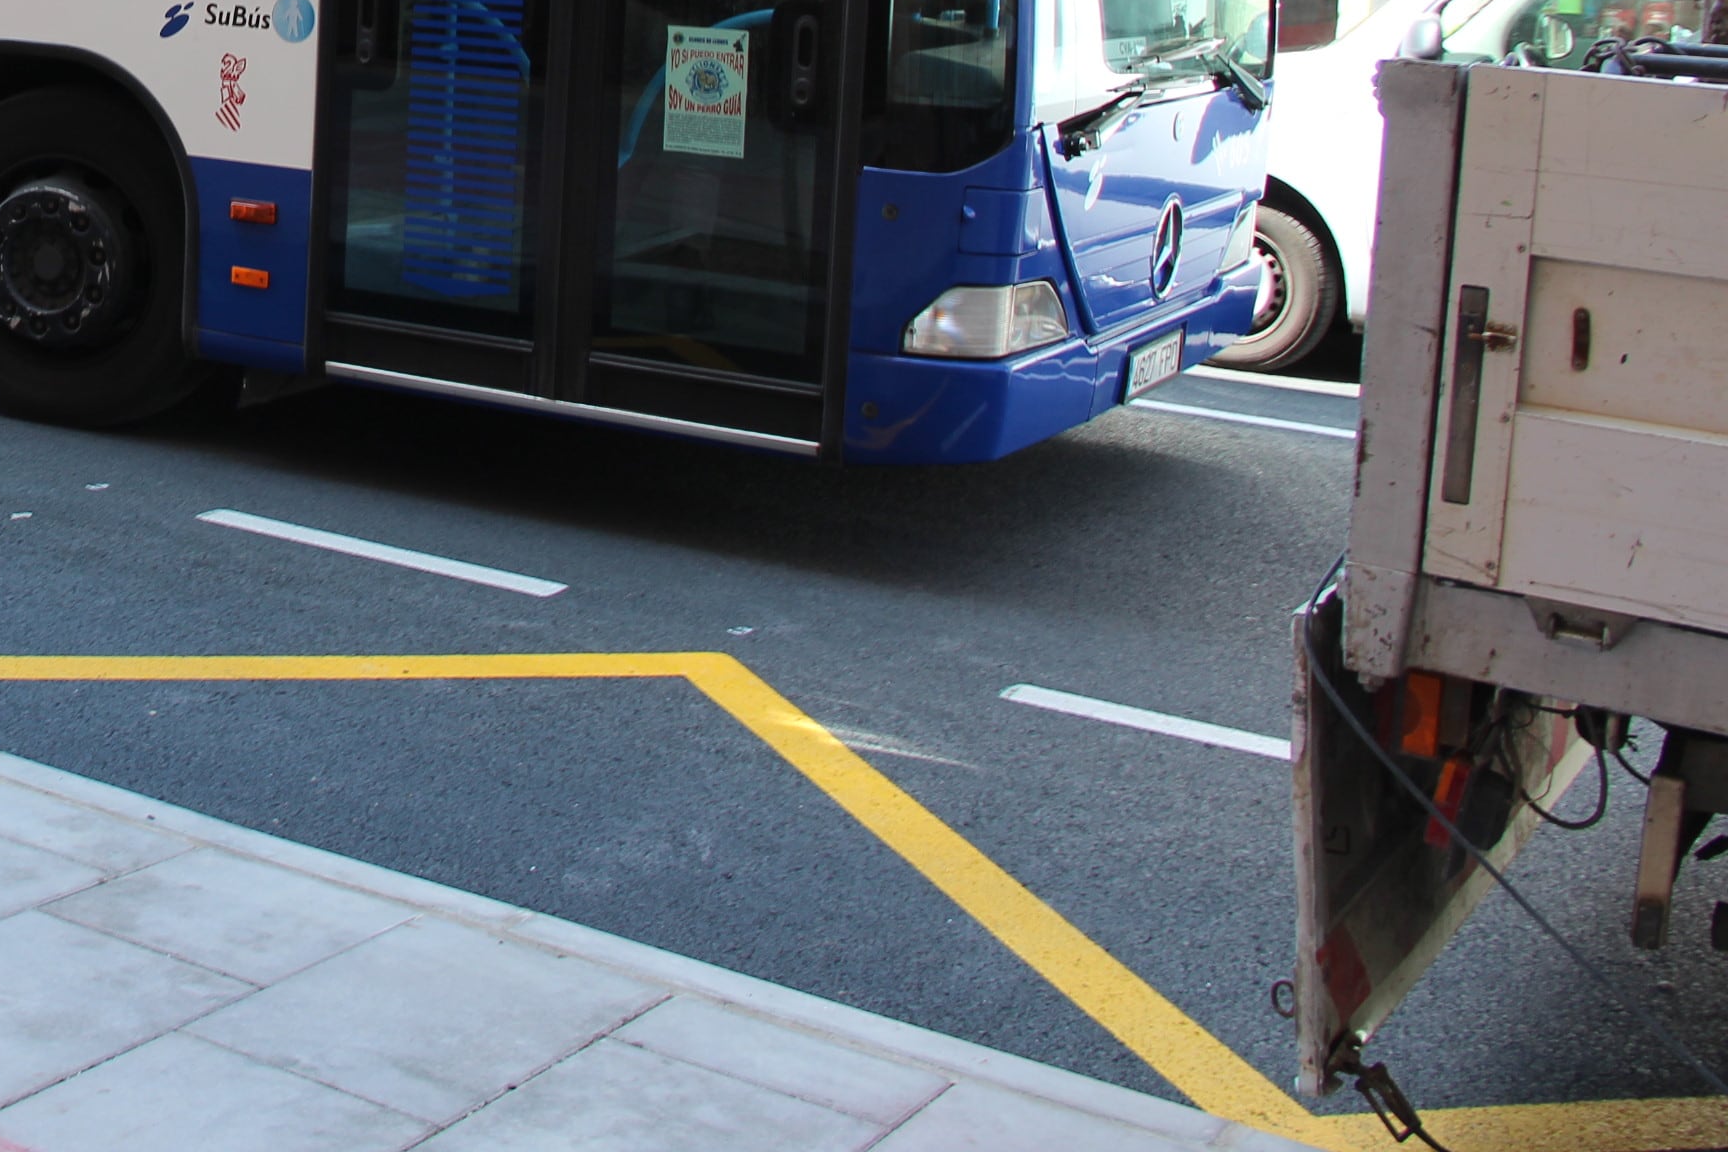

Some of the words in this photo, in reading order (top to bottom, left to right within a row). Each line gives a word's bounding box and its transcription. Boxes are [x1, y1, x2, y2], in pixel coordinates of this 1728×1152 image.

[204, 2, 271, 29] SuBús
[670, 48, 681, 73] YO
[716, 52, 744, 80] ENTRAR
[668, 84, 683, 110] SOY
[685, 97, 696, 112] UN
